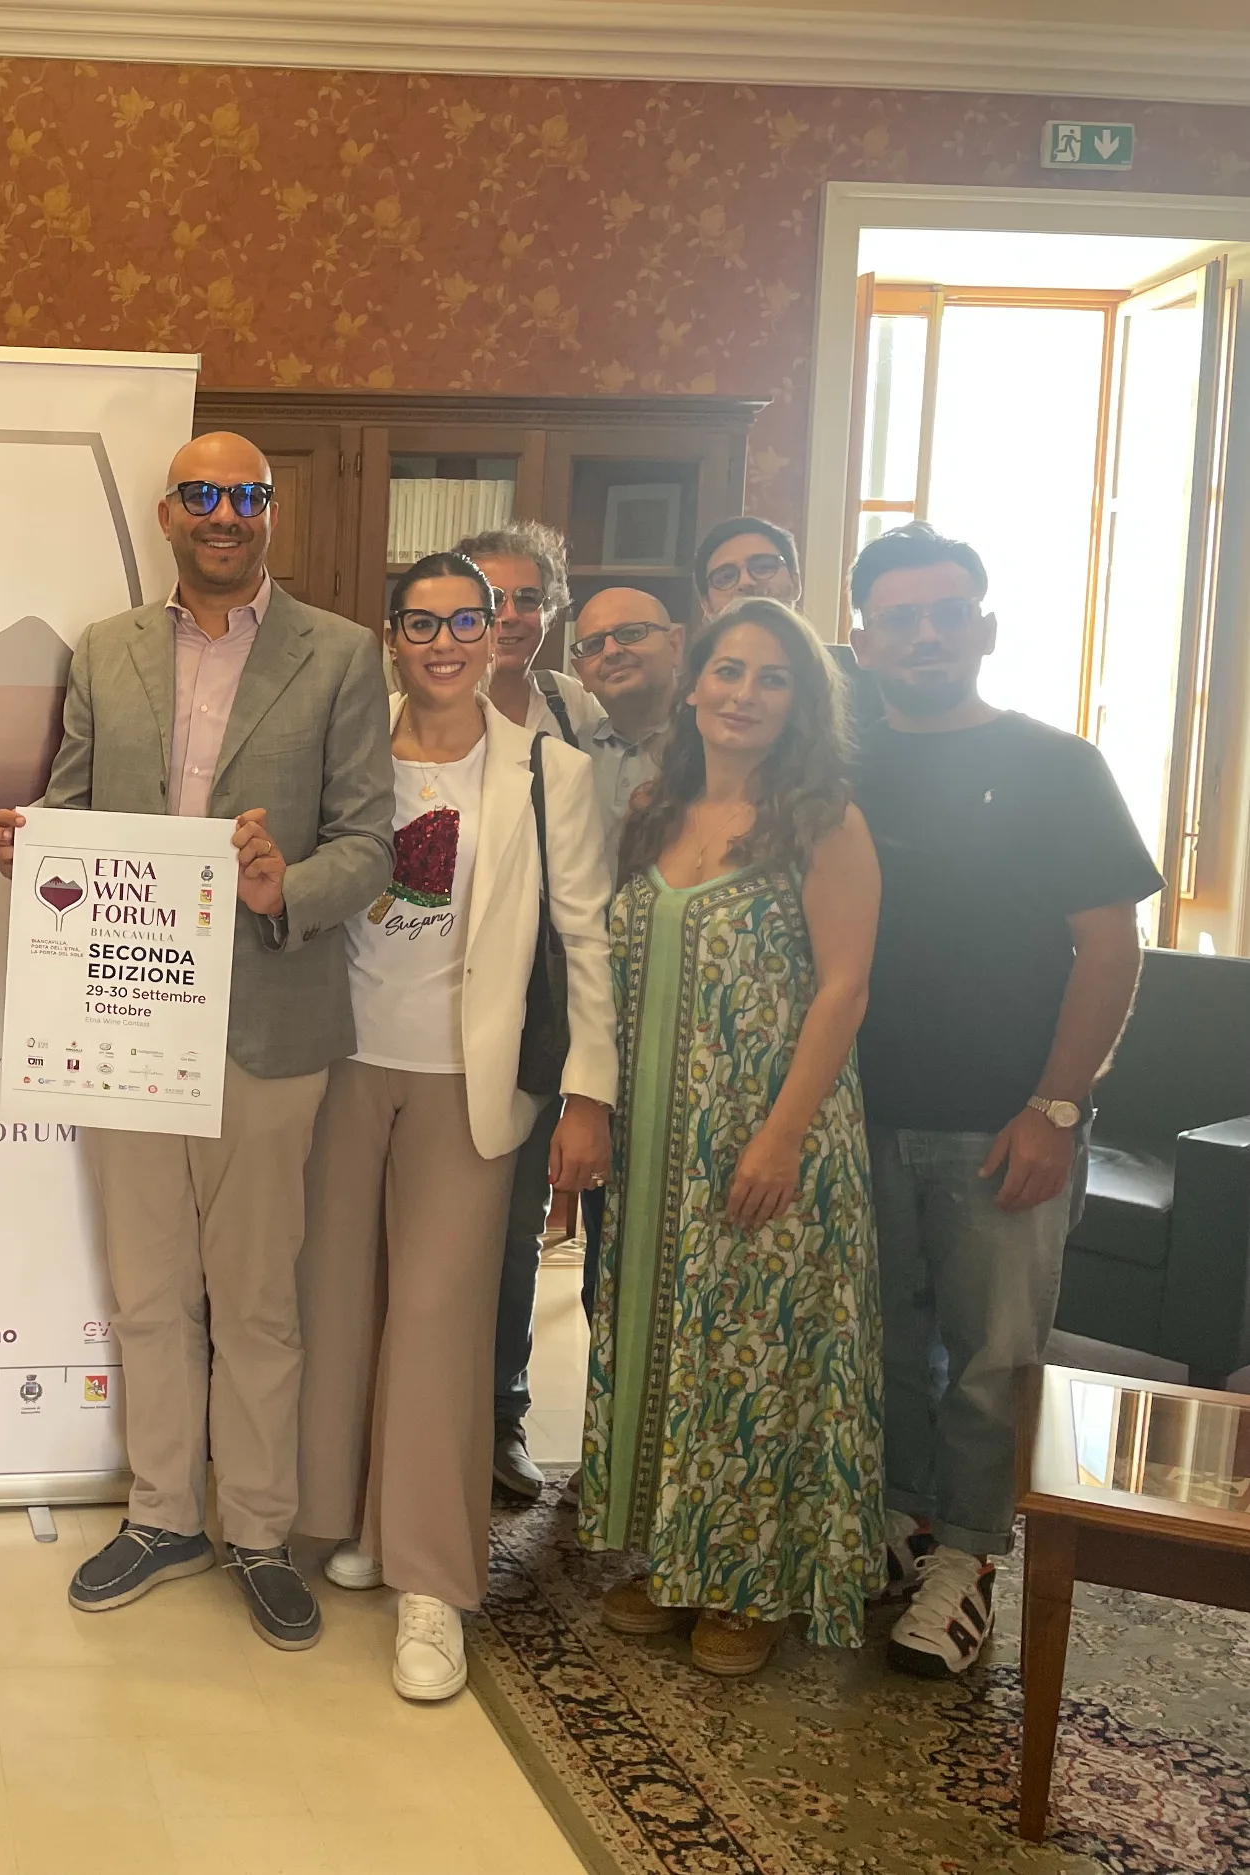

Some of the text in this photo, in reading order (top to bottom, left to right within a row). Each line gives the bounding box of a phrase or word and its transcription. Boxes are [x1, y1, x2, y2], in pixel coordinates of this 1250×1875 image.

[95, 858, 157, 880] ETNA
[93, 881, 158, 903] WINE
[92, 903, 176, 928] FORUM
[90, 927, 175, 943] BIANCAVILLA
[88, 943, 195, 966] SECONDA
[87, 963, 195, 985] EDIZIONE
[85, 984, 207, 1004] 29-30 Settembre
[84, 1001, 152, 1017] 1 Ottobre
[84, 1016, 101, 1024] Etna
[102, 1017, 121, 1025] Wine
